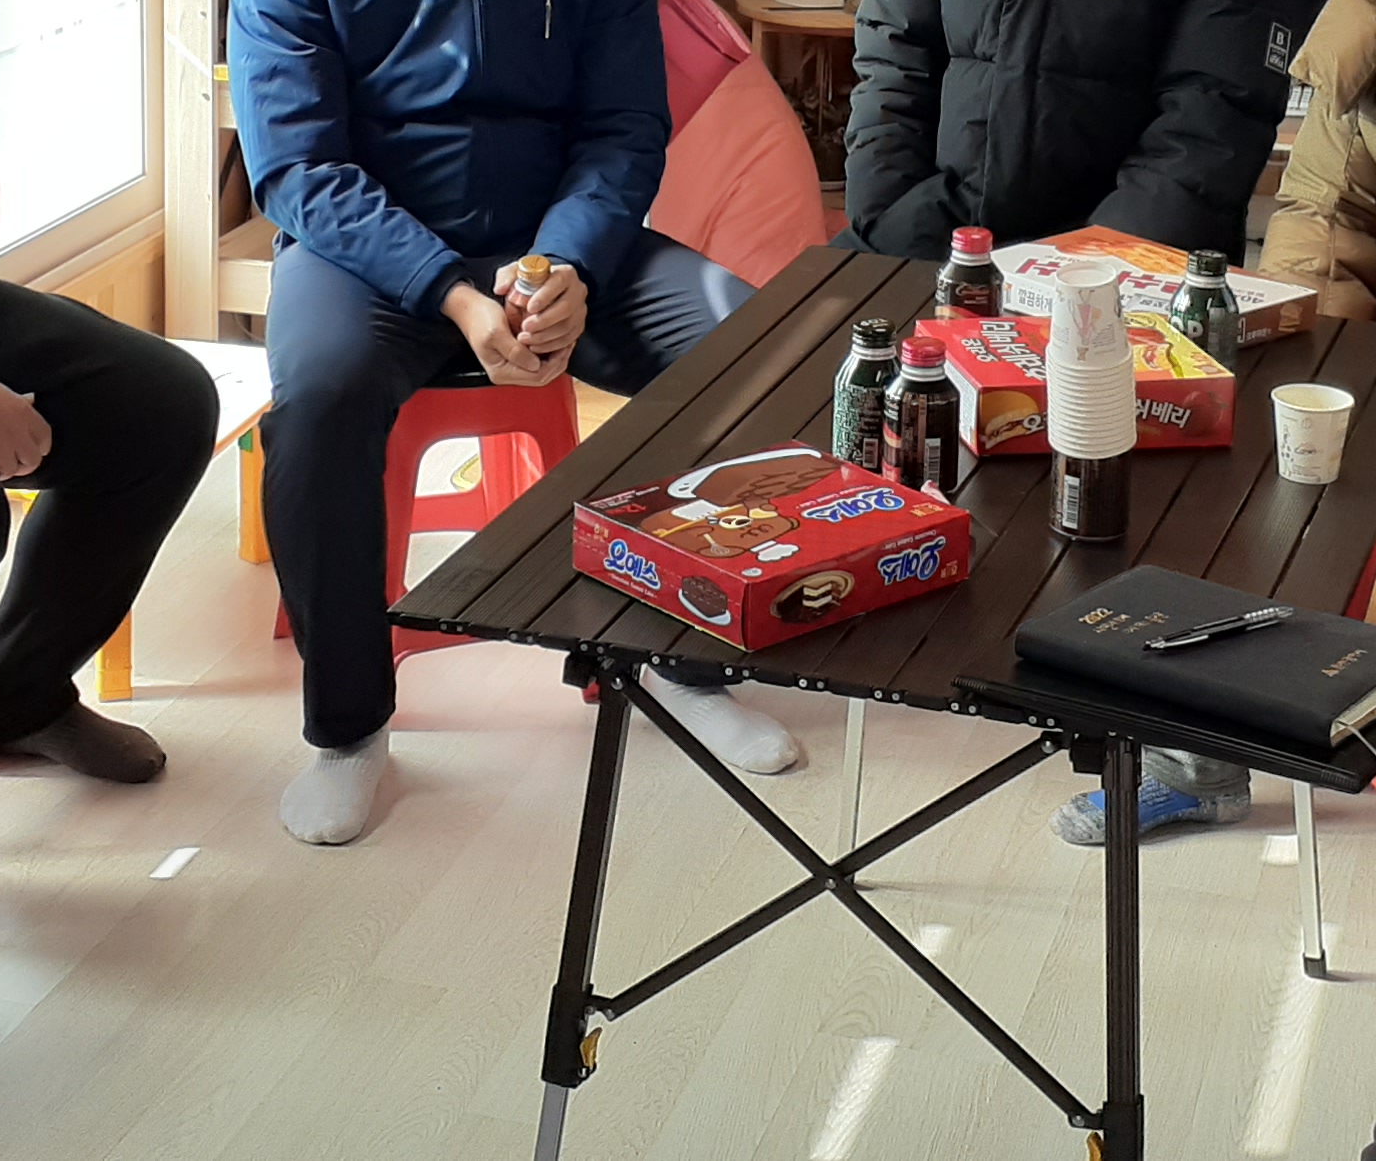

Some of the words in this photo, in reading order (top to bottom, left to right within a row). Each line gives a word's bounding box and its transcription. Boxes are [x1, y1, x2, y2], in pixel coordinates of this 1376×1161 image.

[1136, 399, 1191, 429] 쉬베리
[800, 487, 905, 525] 오예스
[603, 538, 661, 591] 오예스
[877, 536, 946, 586] 오예스
